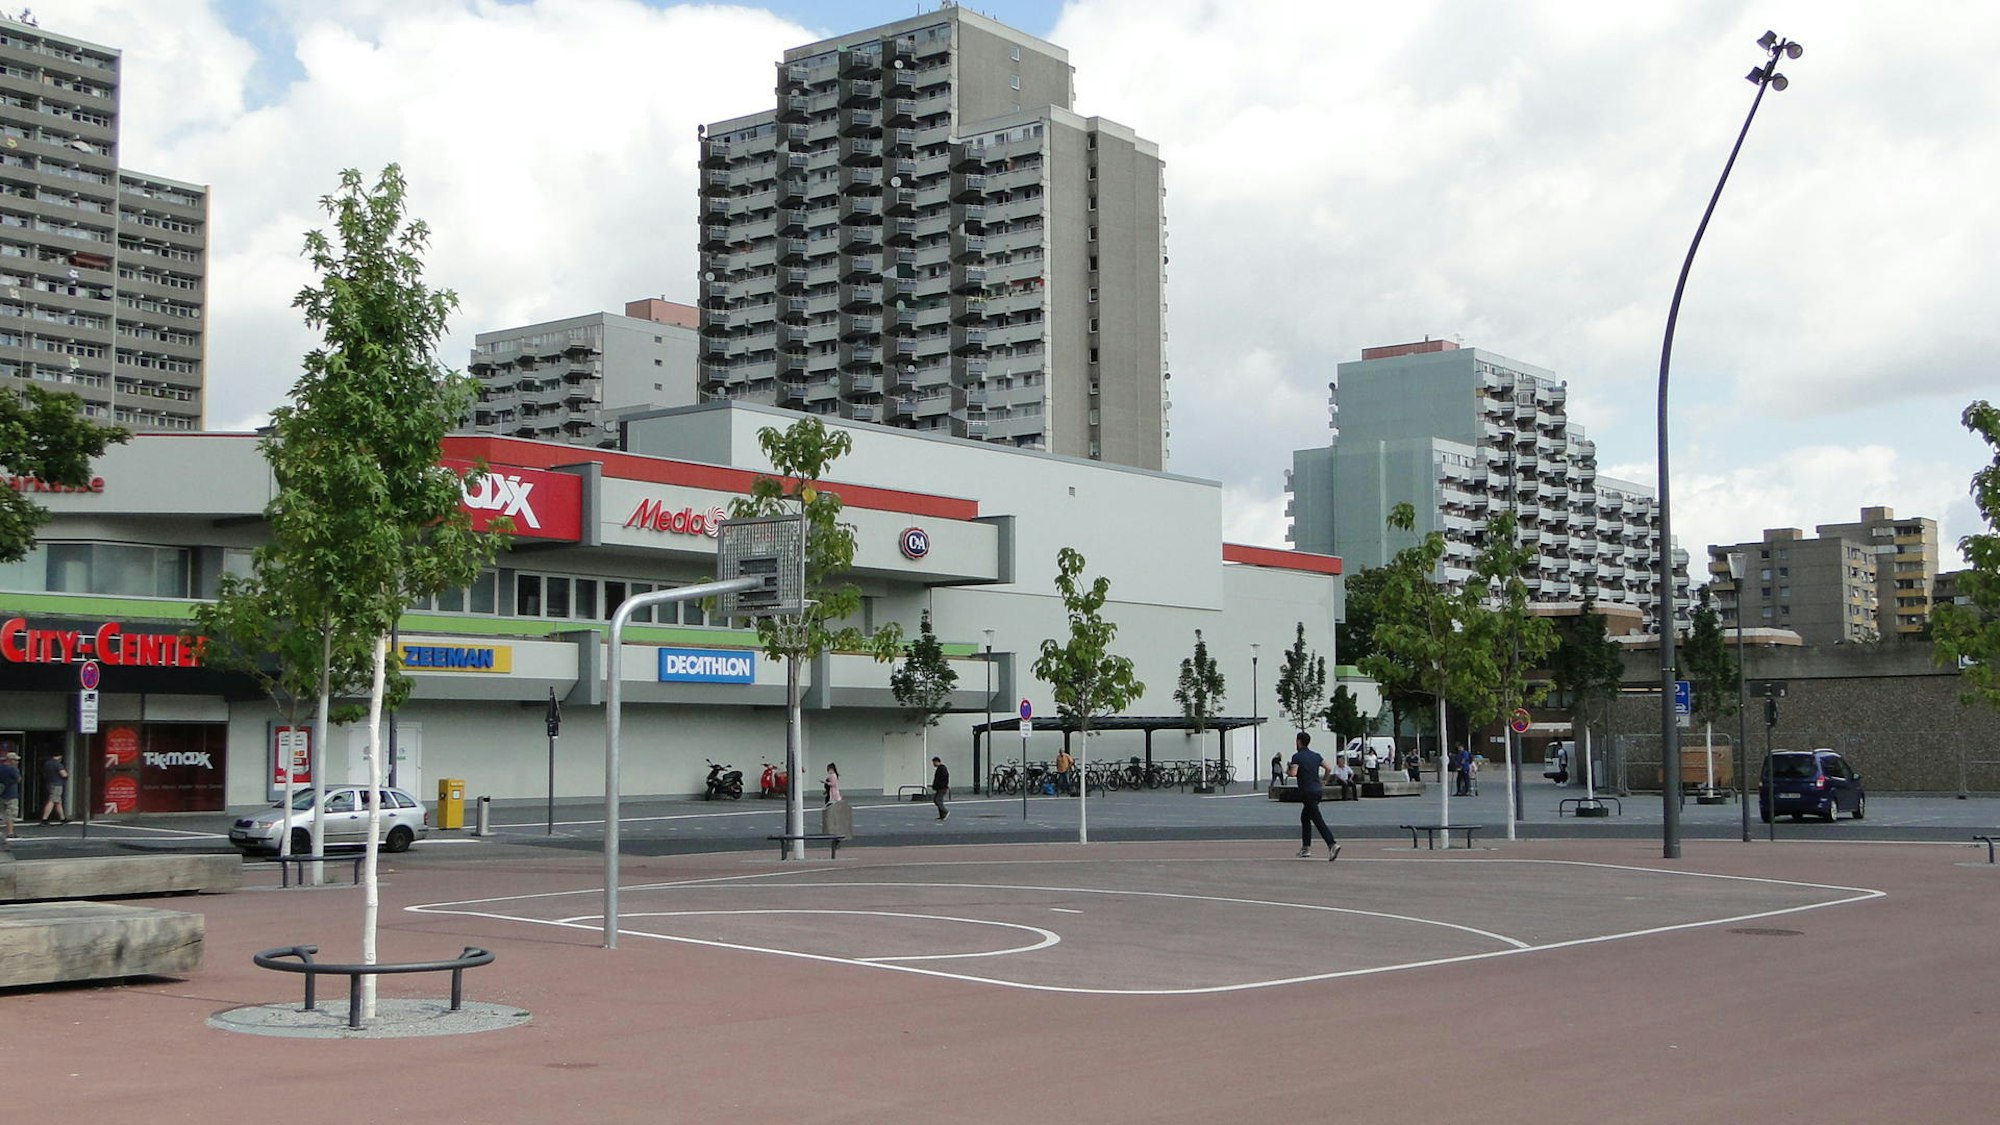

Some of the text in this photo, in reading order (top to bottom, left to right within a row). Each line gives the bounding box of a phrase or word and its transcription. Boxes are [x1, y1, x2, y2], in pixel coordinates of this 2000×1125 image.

[624, 499, 705, 535] Media
[403, 646, 495, 668] ZEEMAN
[667, 655, 750, 676] DECATHLON
